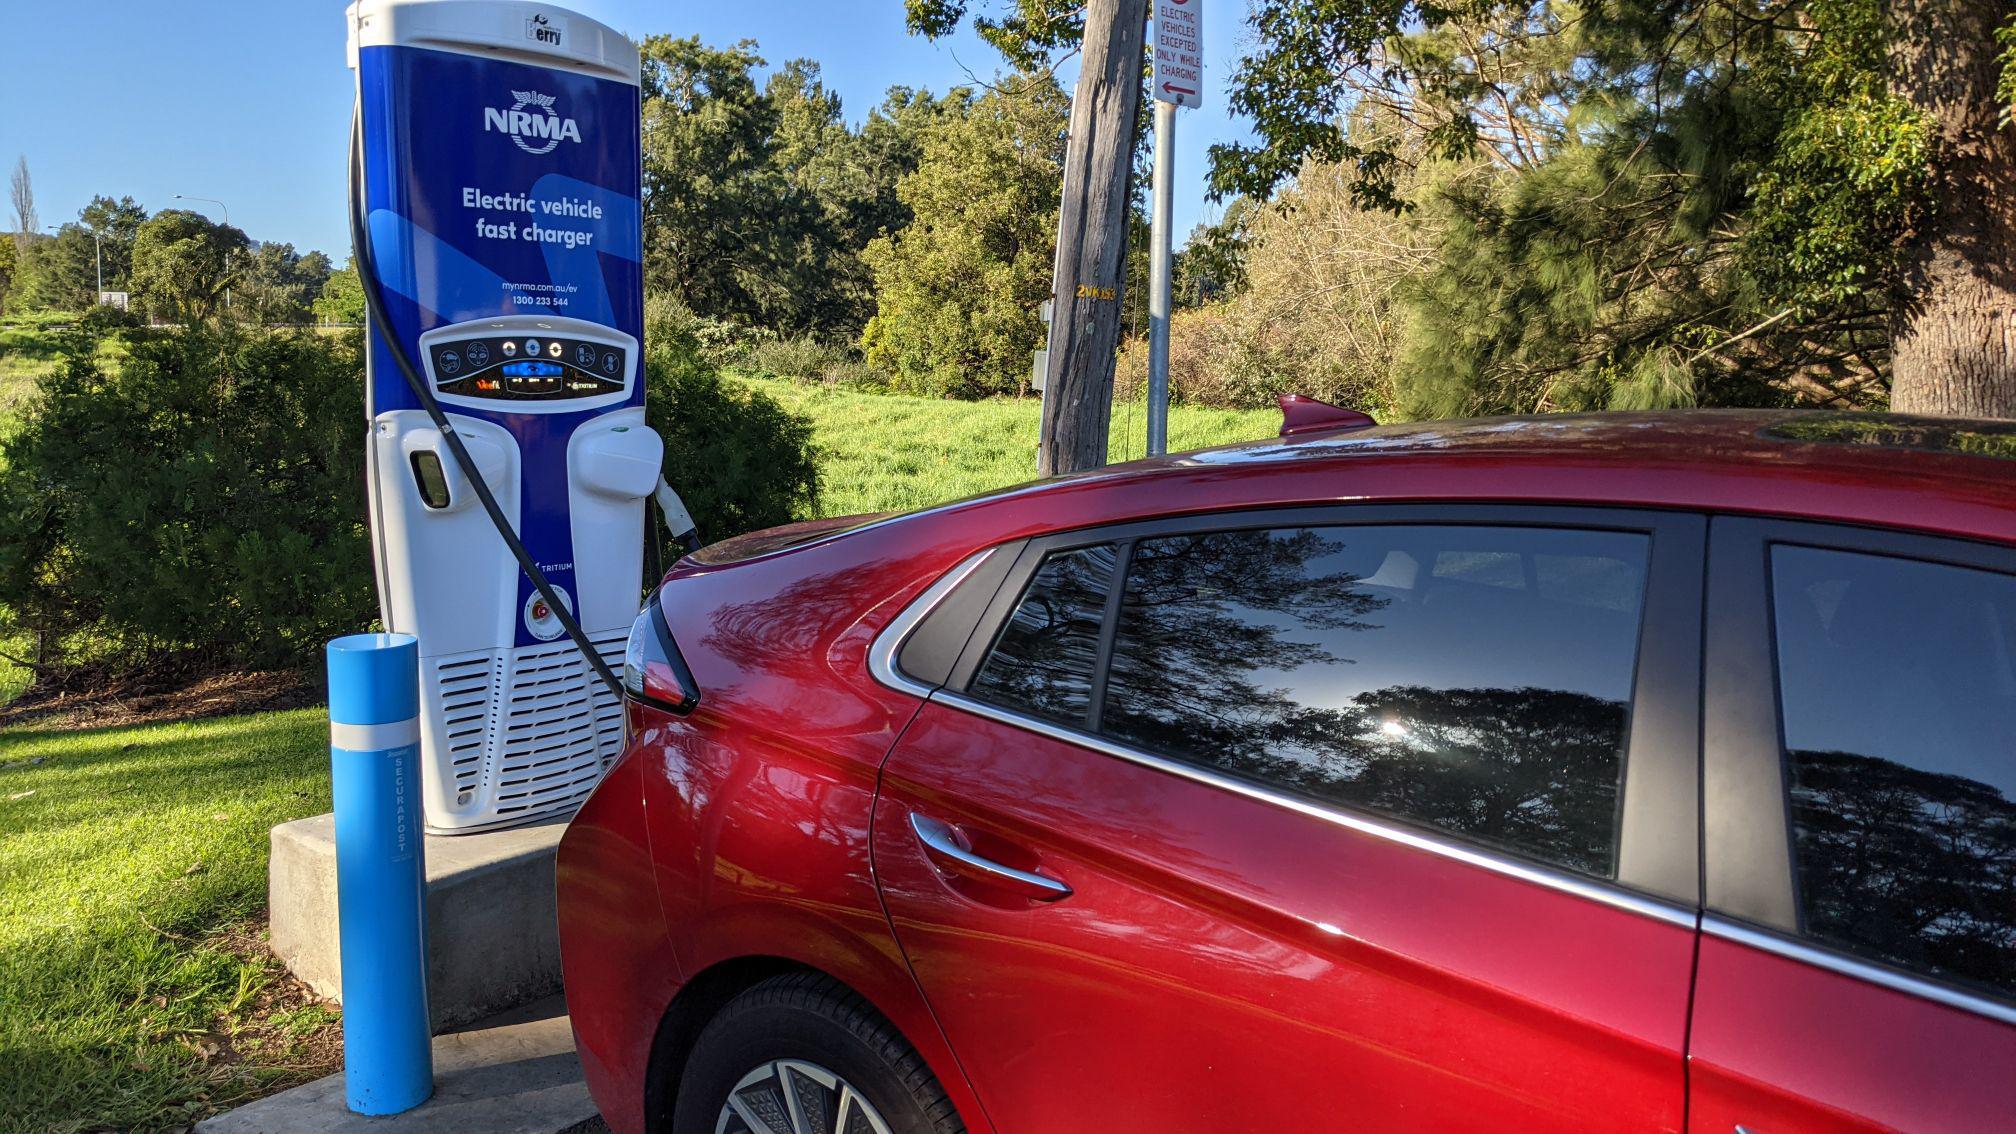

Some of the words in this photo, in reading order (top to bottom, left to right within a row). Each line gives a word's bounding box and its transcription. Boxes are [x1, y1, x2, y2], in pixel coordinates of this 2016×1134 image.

[1161, 6, 1195, 24] ELECTRIC
[1161, 21, 1195, 37] VEHICLES
[1160, 35, 1197, 52] EXCEPTED
[1157, 49, 1177, 62] ONLY
[1180, 55, 1200, 68] WHILE
[1161, 64, 1197, 81] CHARGING
[485, 107, 582, 144] NRMA
[462, 187, 536, 213] Electric
[541, 197, 603, 219] vehicle
[476, 217, 517, 239] fast
[522, 222, 593, 249] charger
[502, 281, 578, 293] mynrma.com.au/ev
[513, 295, 534, 305] 1300
[536, 296, 551, 305] 233
[553, 297, 569, 306] 544
[541, 562, 573, 572] TRITIUM
[395, 758, 406, 852] SECURAPOST
